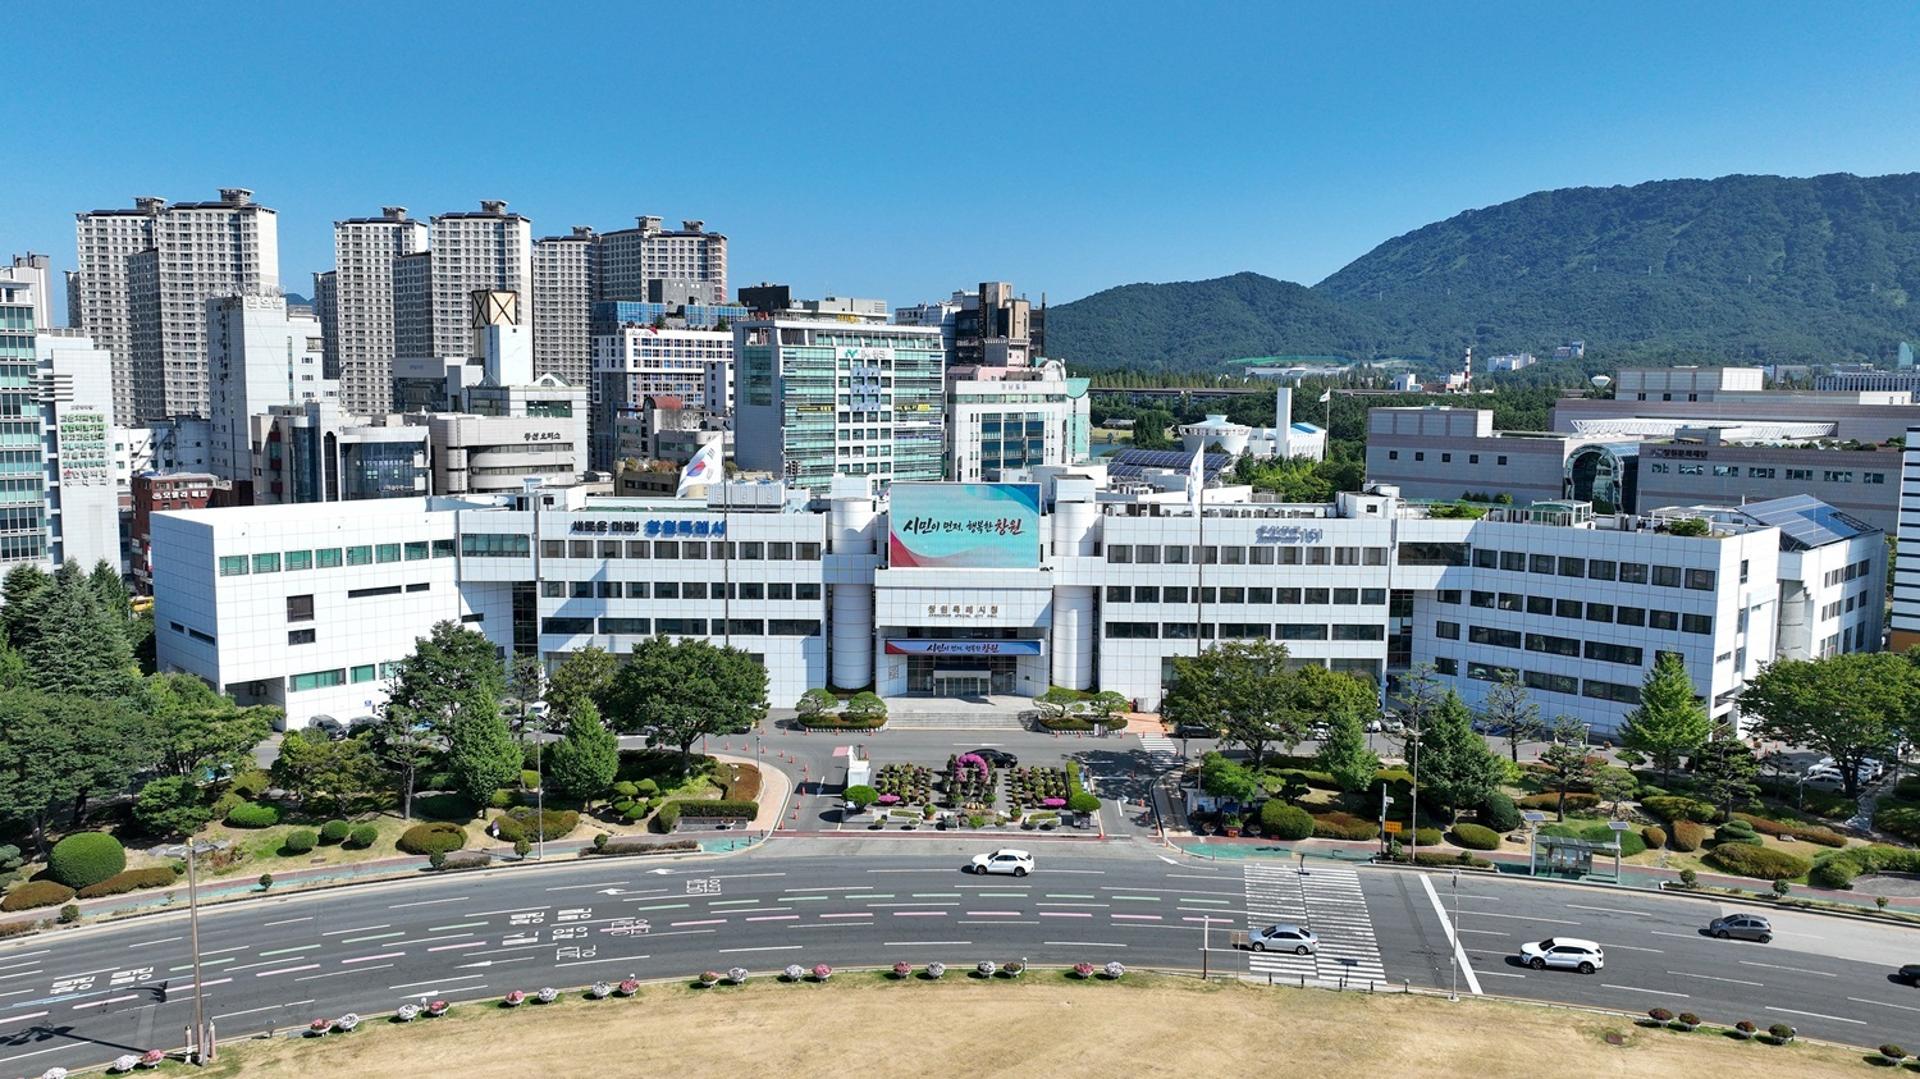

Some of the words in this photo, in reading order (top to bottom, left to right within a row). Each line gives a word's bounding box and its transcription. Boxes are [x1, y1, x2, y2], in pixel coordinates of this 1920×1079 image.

[571, 520, 608, 533] 새로운
[611, 520, 640, 533] 미래!
[645, 519, 727, 535] 창원특례시
[903, 516, 941, 535] 시민이
[966, 519, 994, 534] 행복한
[994, 518, 1026, 536] 창원
[926, 643, 949, 653] 시민이
[981, 643, 1001, 654] 창원
